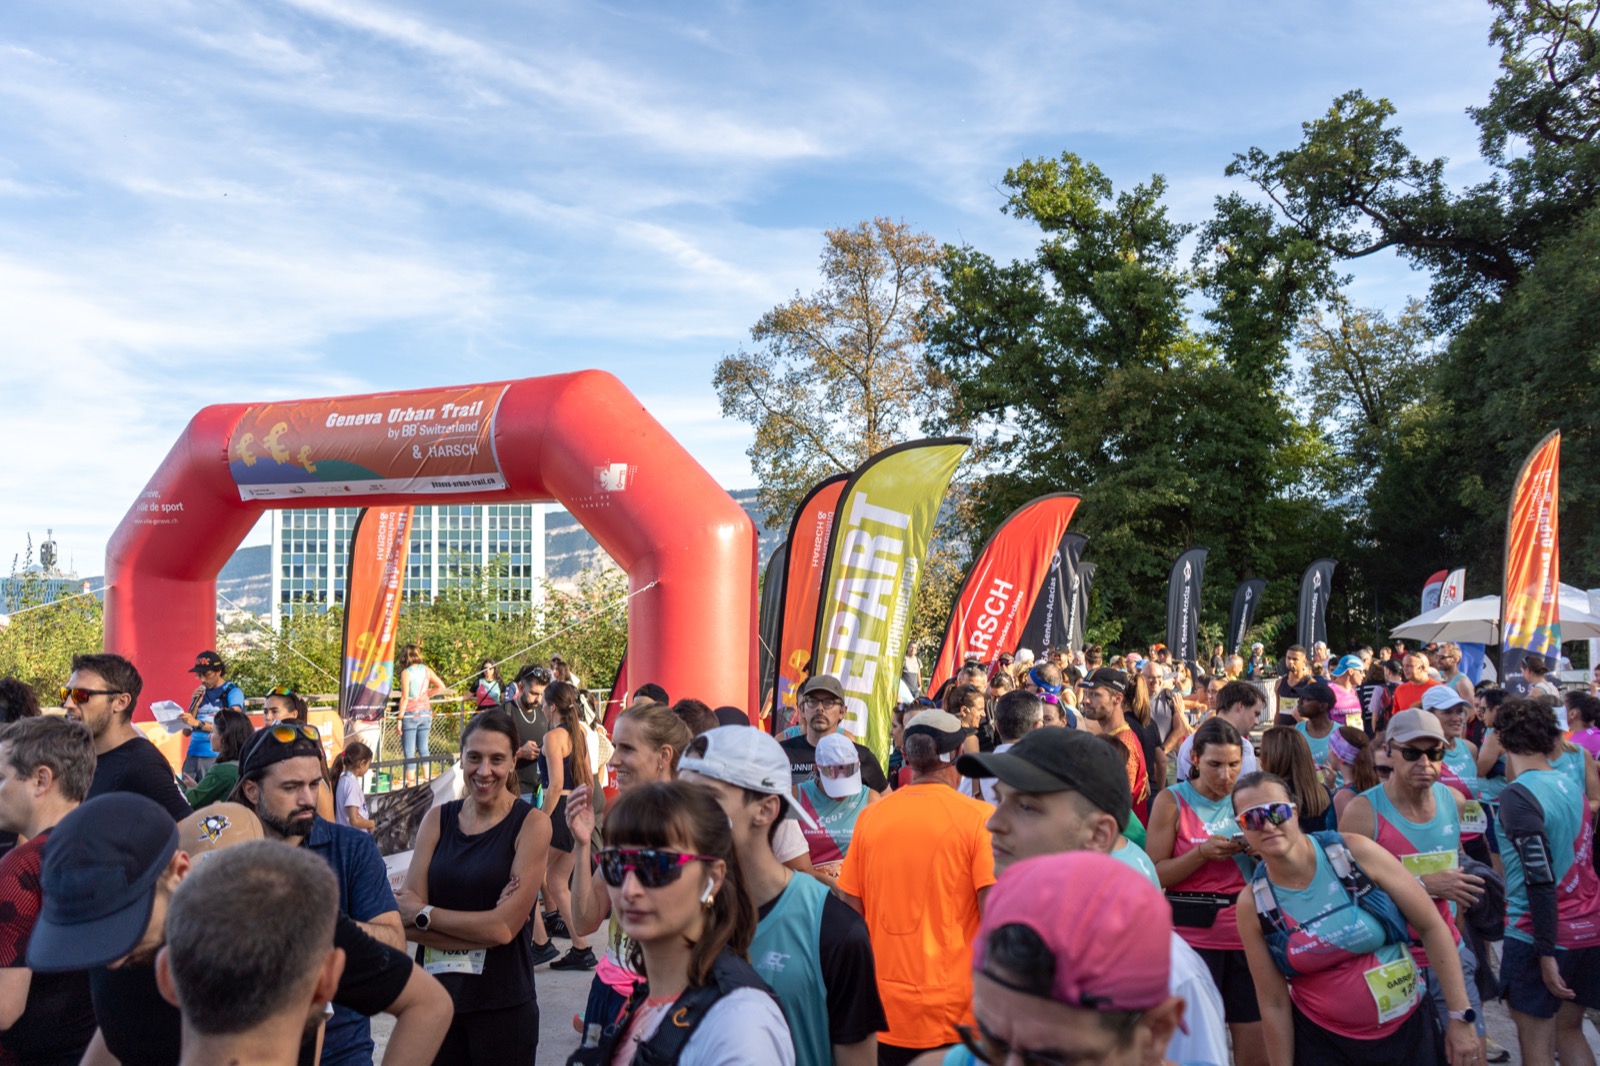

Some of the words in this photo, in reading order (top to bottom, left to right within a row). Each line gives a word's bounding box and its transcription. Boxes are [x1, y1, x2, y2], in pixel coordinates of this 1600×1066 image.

[326, 412, 383, 428] Geneva
[387, 407, 435, 424] Urban
[441, 400, 484, 419] Trail
[387, 428, 399, 440] by
[419, 420, 478, 436] Switzerland
[412, 444, 422, 459] &
[429, 443, 479, 458] HARSCH
[150, 502, 159, 511] de
[161, 502, 184, 514] sport
[964, 578, 1014, 660] ARSCH
[1043, 577, 1057, 645] Genève-Acacias
[790, 763, 814, 772] UNNI
[1290, 940, 1318, 955] Geneva
[1318, 930, 1344, 943] Urban
